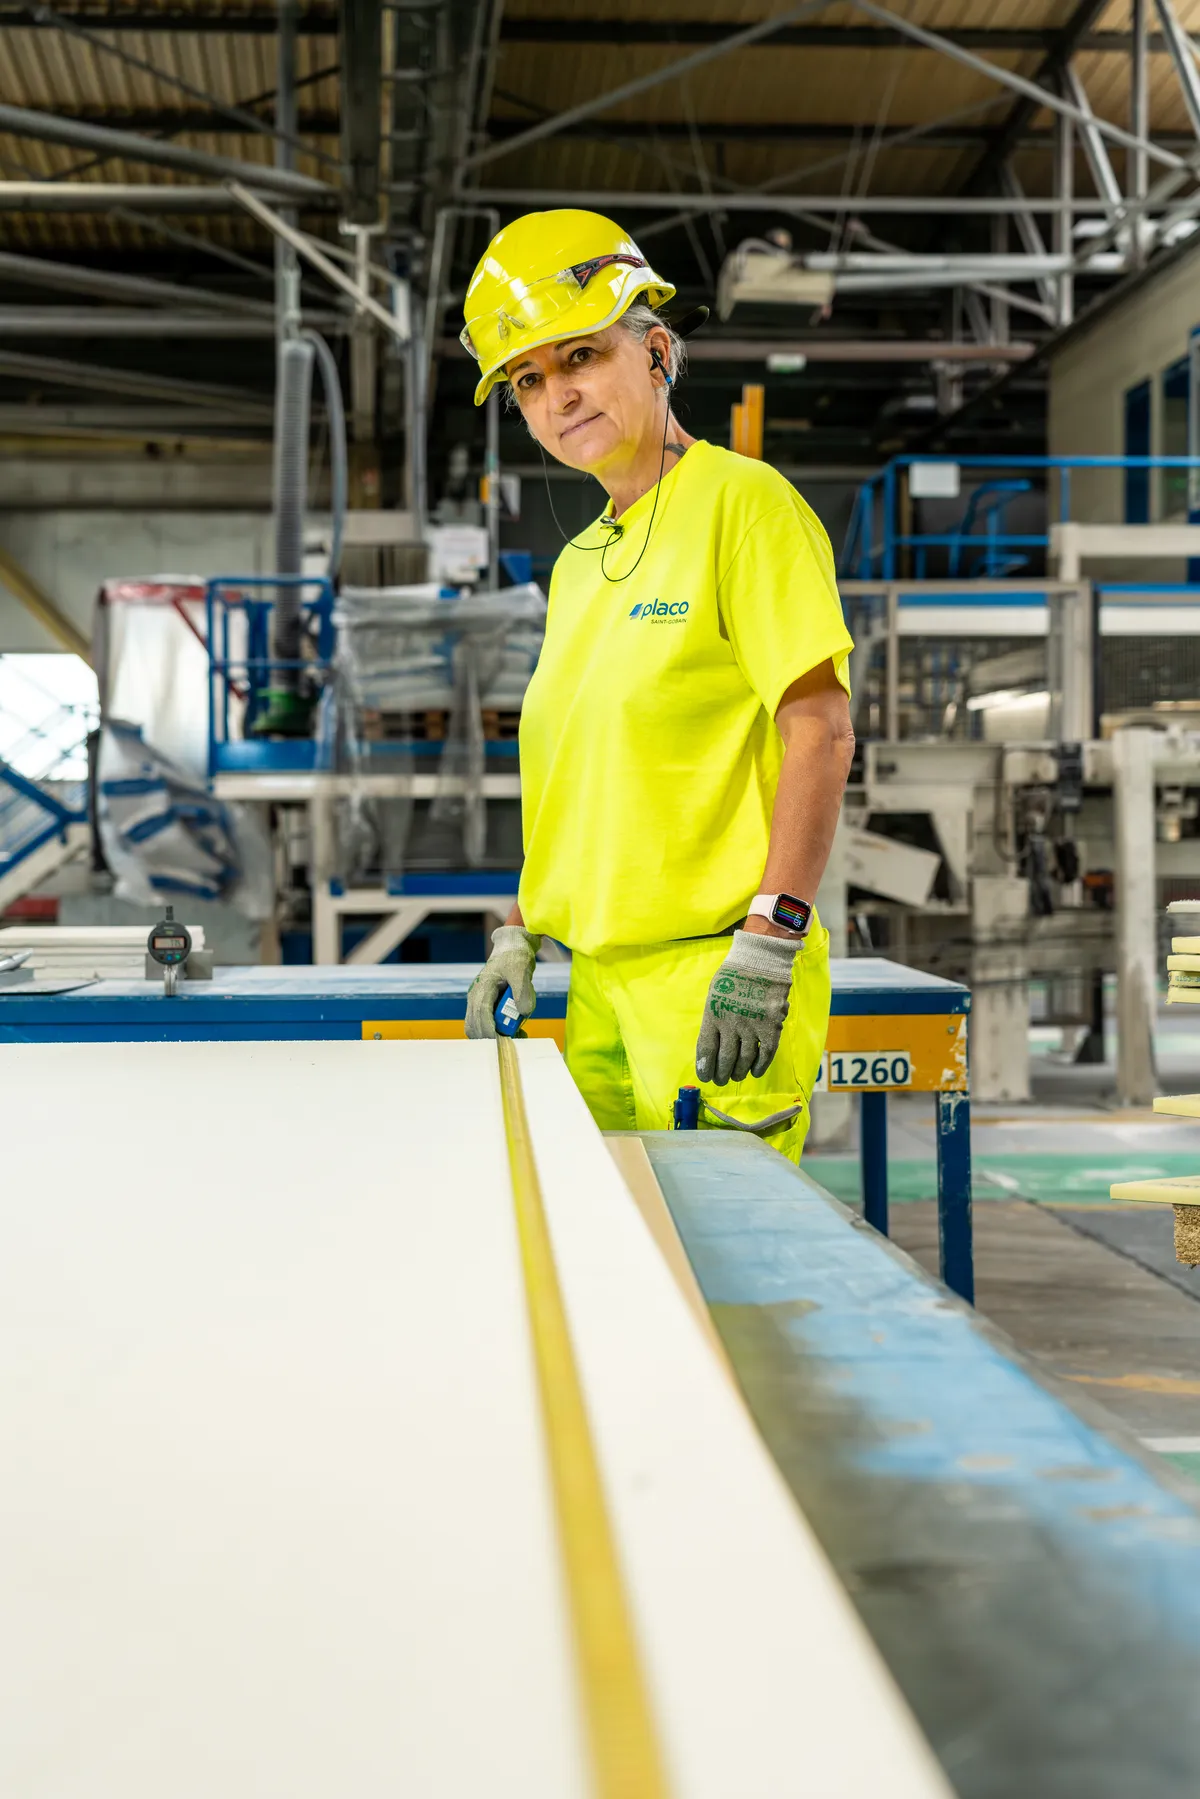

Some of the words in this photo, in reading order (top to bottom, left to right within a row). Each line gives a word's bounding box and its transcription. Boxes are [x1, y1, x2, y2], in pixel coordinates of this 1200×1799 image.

[640, 598, 689, 620] placo
[720, 1001, 766, 1021] LEBON
[832, 1057, 909, 1085] 1260
